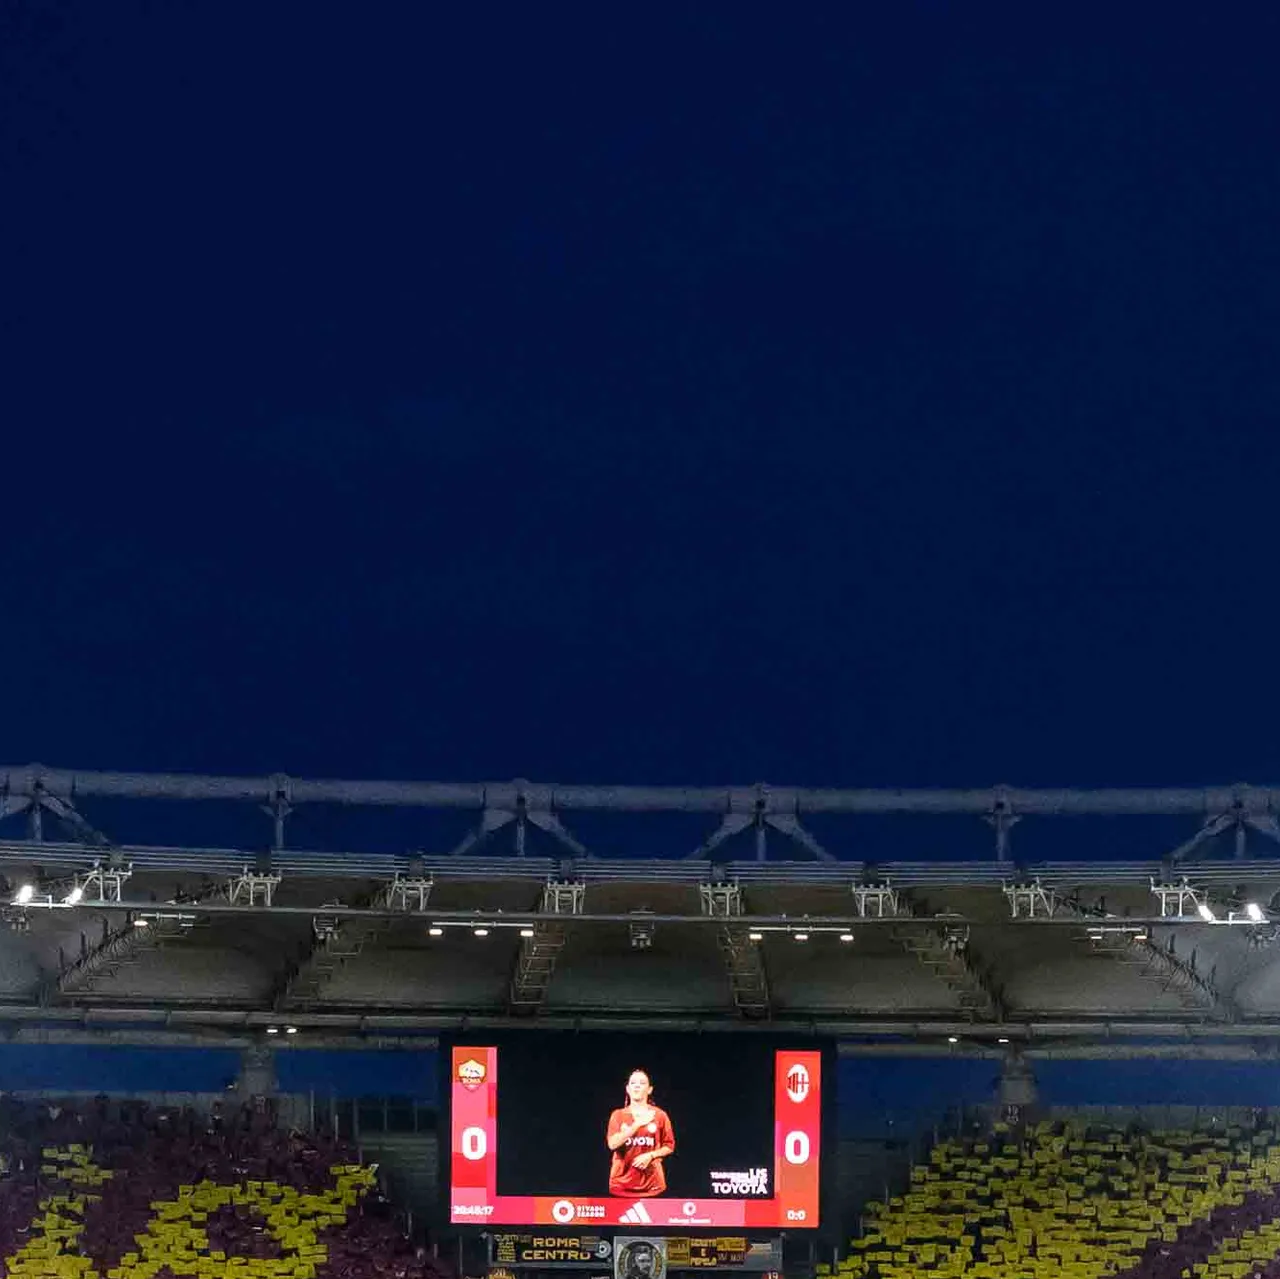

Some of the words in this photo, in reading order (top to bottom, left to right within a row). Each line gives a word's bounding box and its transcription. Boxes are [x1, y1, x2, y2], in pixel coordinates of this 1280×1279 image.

[462, 1126, 487, 1160] 0
[784, 1130, 810, 1164] 0
[712, 1183, 768, 1195] TOYOTA
[533, 1237, 580, 1248] ROMA
[521, 1249, 591, 1260] CENTRO
